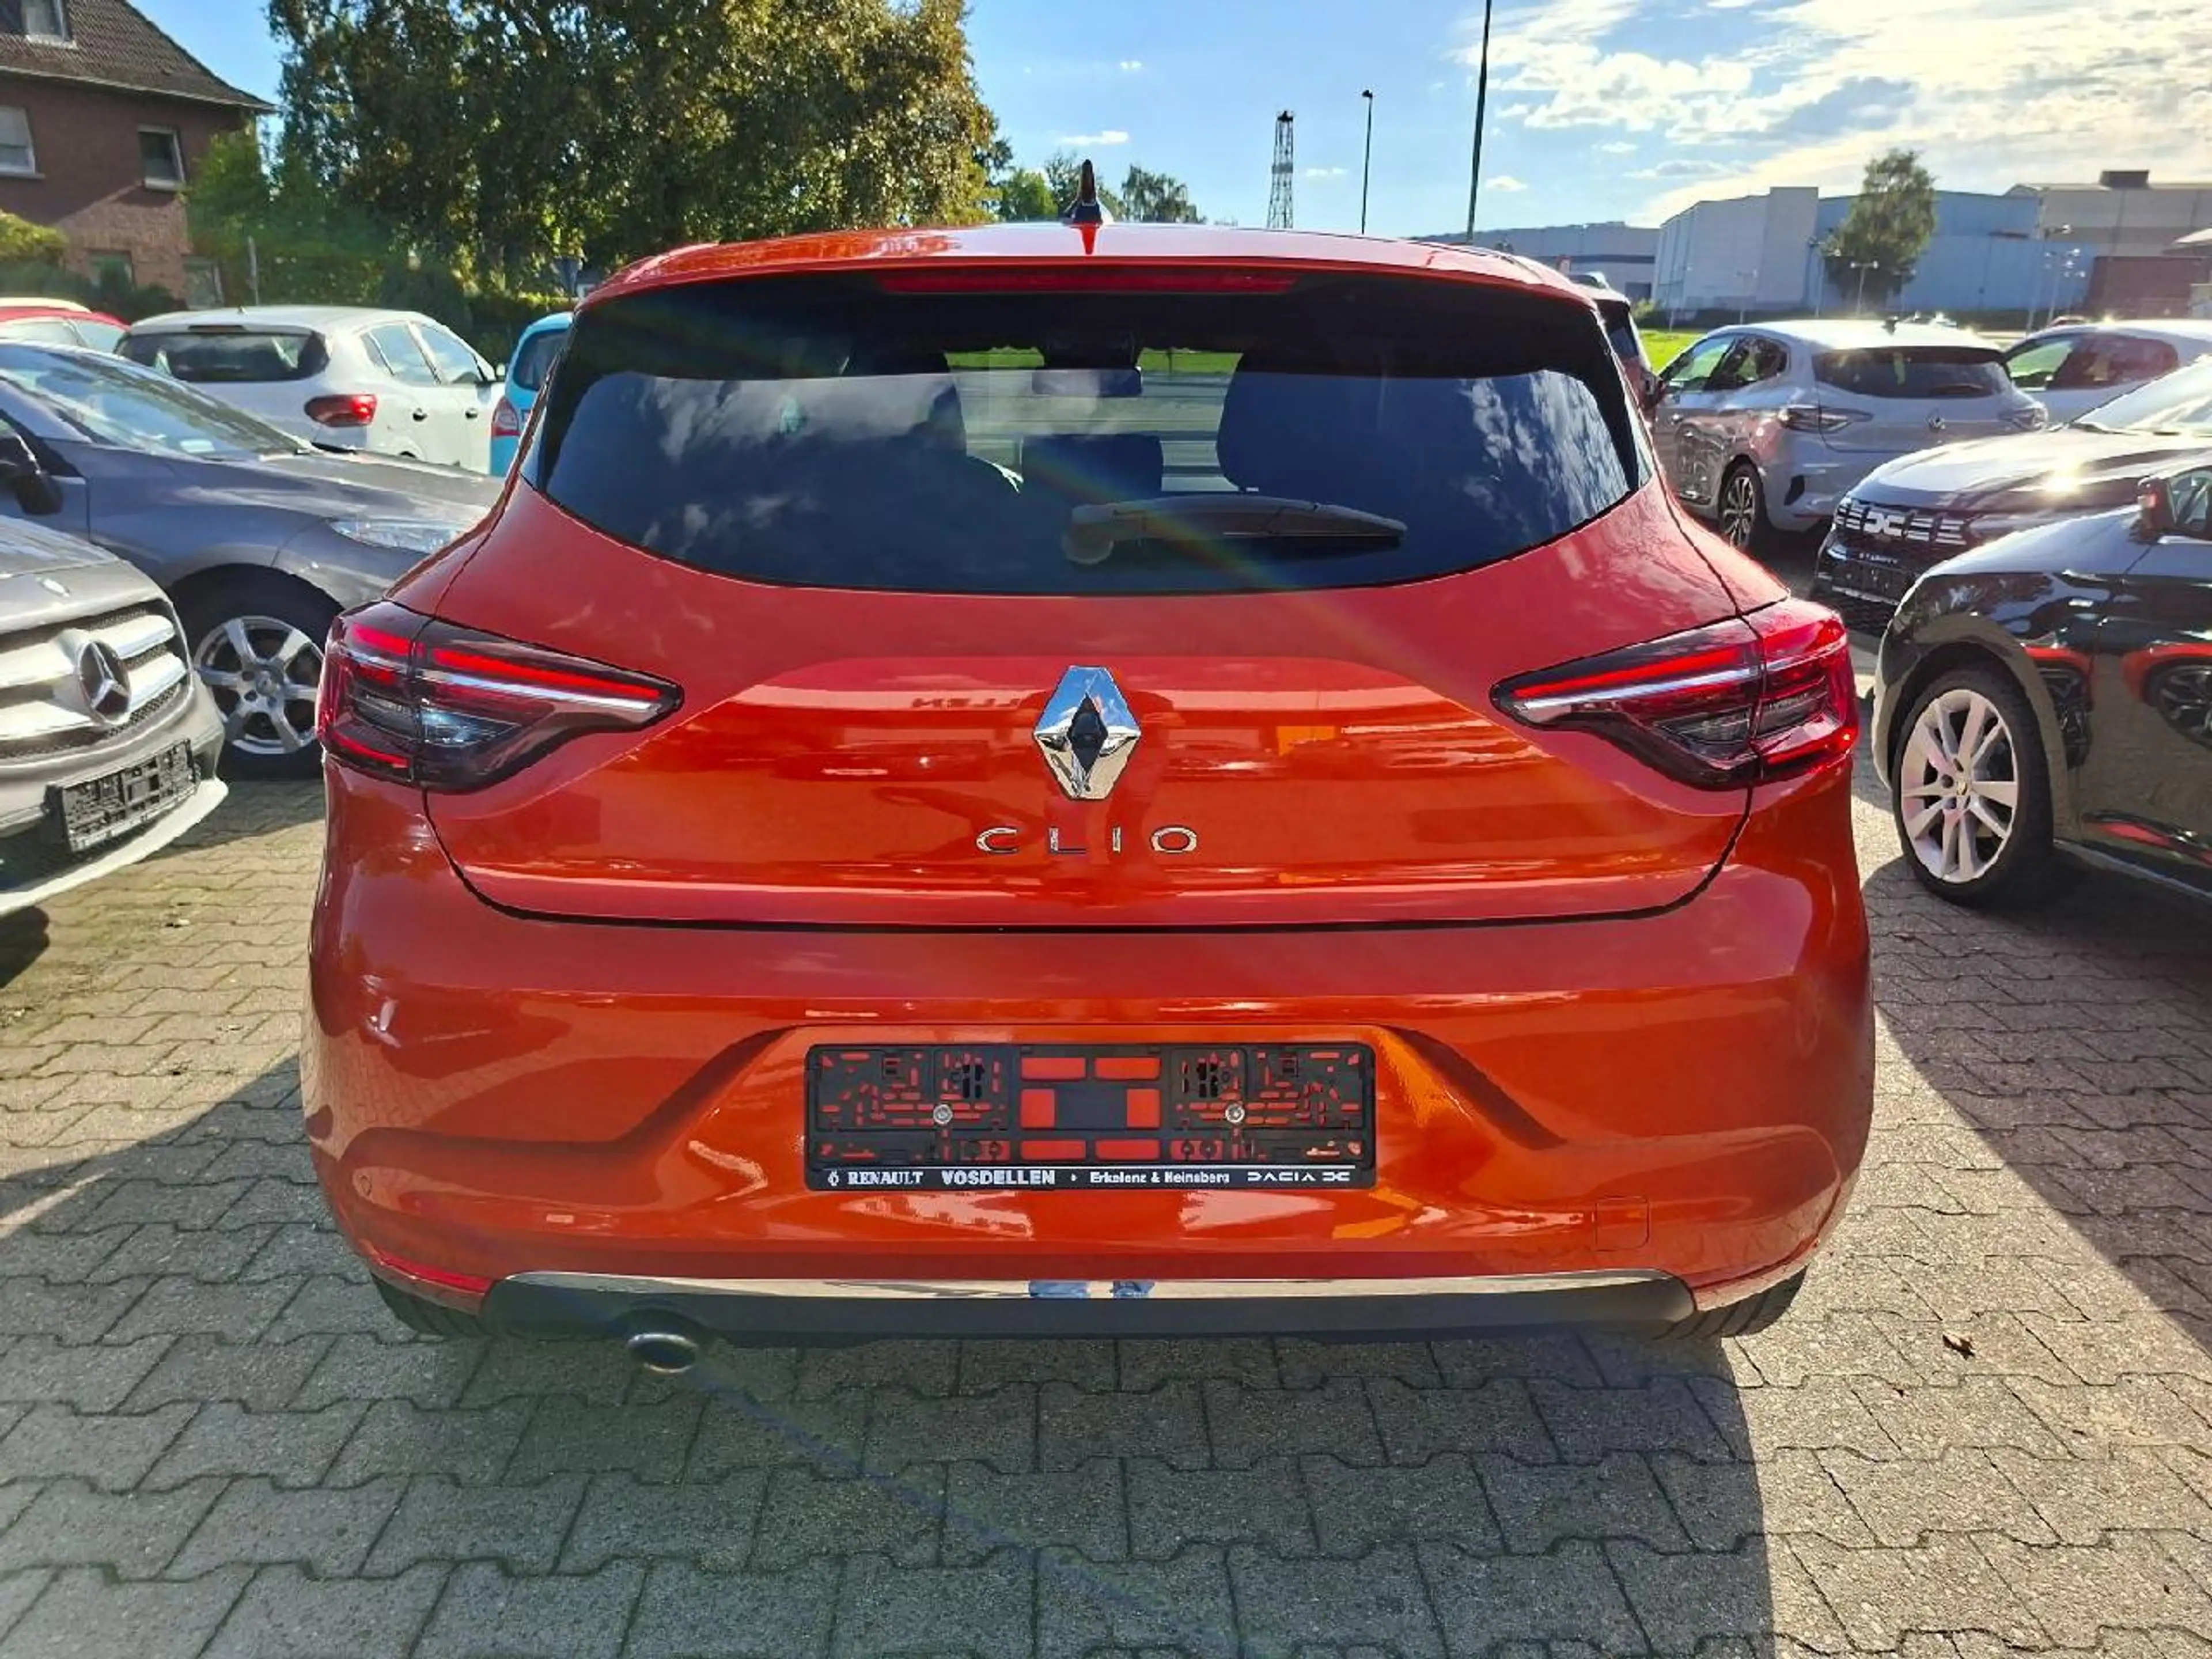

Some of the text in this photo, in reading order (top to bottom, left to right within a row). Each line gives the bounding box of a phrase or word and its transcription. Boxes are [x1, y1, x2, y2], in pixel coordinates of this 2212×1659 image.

[976, 825, 1198, 854] CLIO
[848, 1171, 923, 1185] RENAULT
[942, 1170, 1055, 1185] VOSDELLEN
[1152, 1172, 1160, 1183] &
[1248, 1172, 1316, 1181] DACIA
